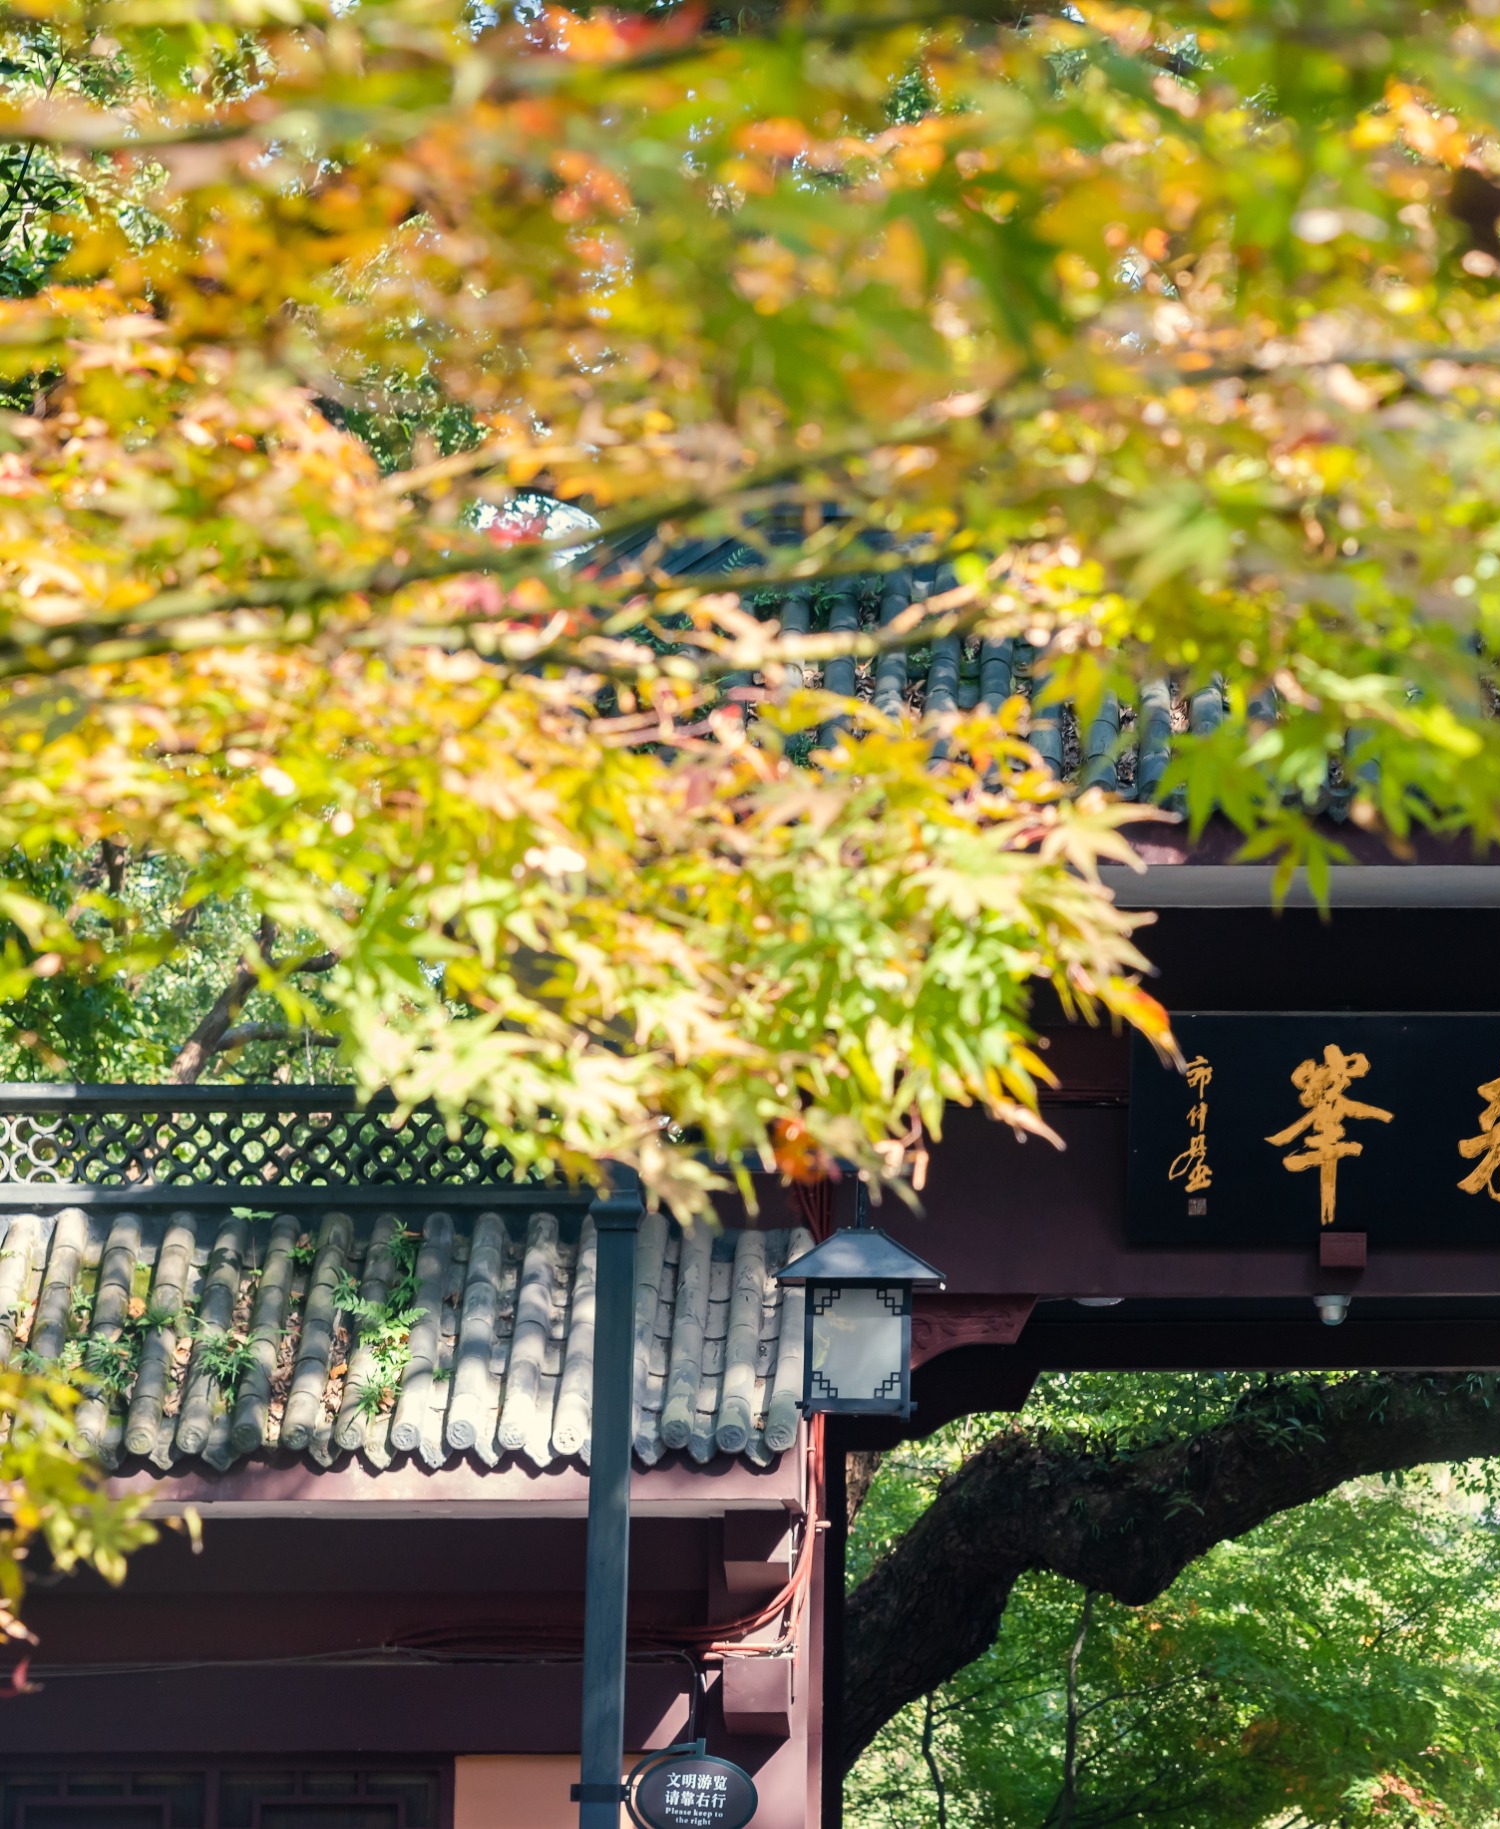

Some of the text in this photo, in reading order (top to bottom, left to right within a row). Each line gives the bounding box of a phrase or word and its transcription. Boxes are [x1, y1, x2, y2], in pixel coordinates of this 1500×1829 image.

[666, 1772, 727, 1791] 文明游览
[665, 1790, 726, 1808] 请靠右行
[665, 1807, 692, 1815] Please
[693, 1809, 713, 1819] keep
[690, 1818, 711, 1826] right
